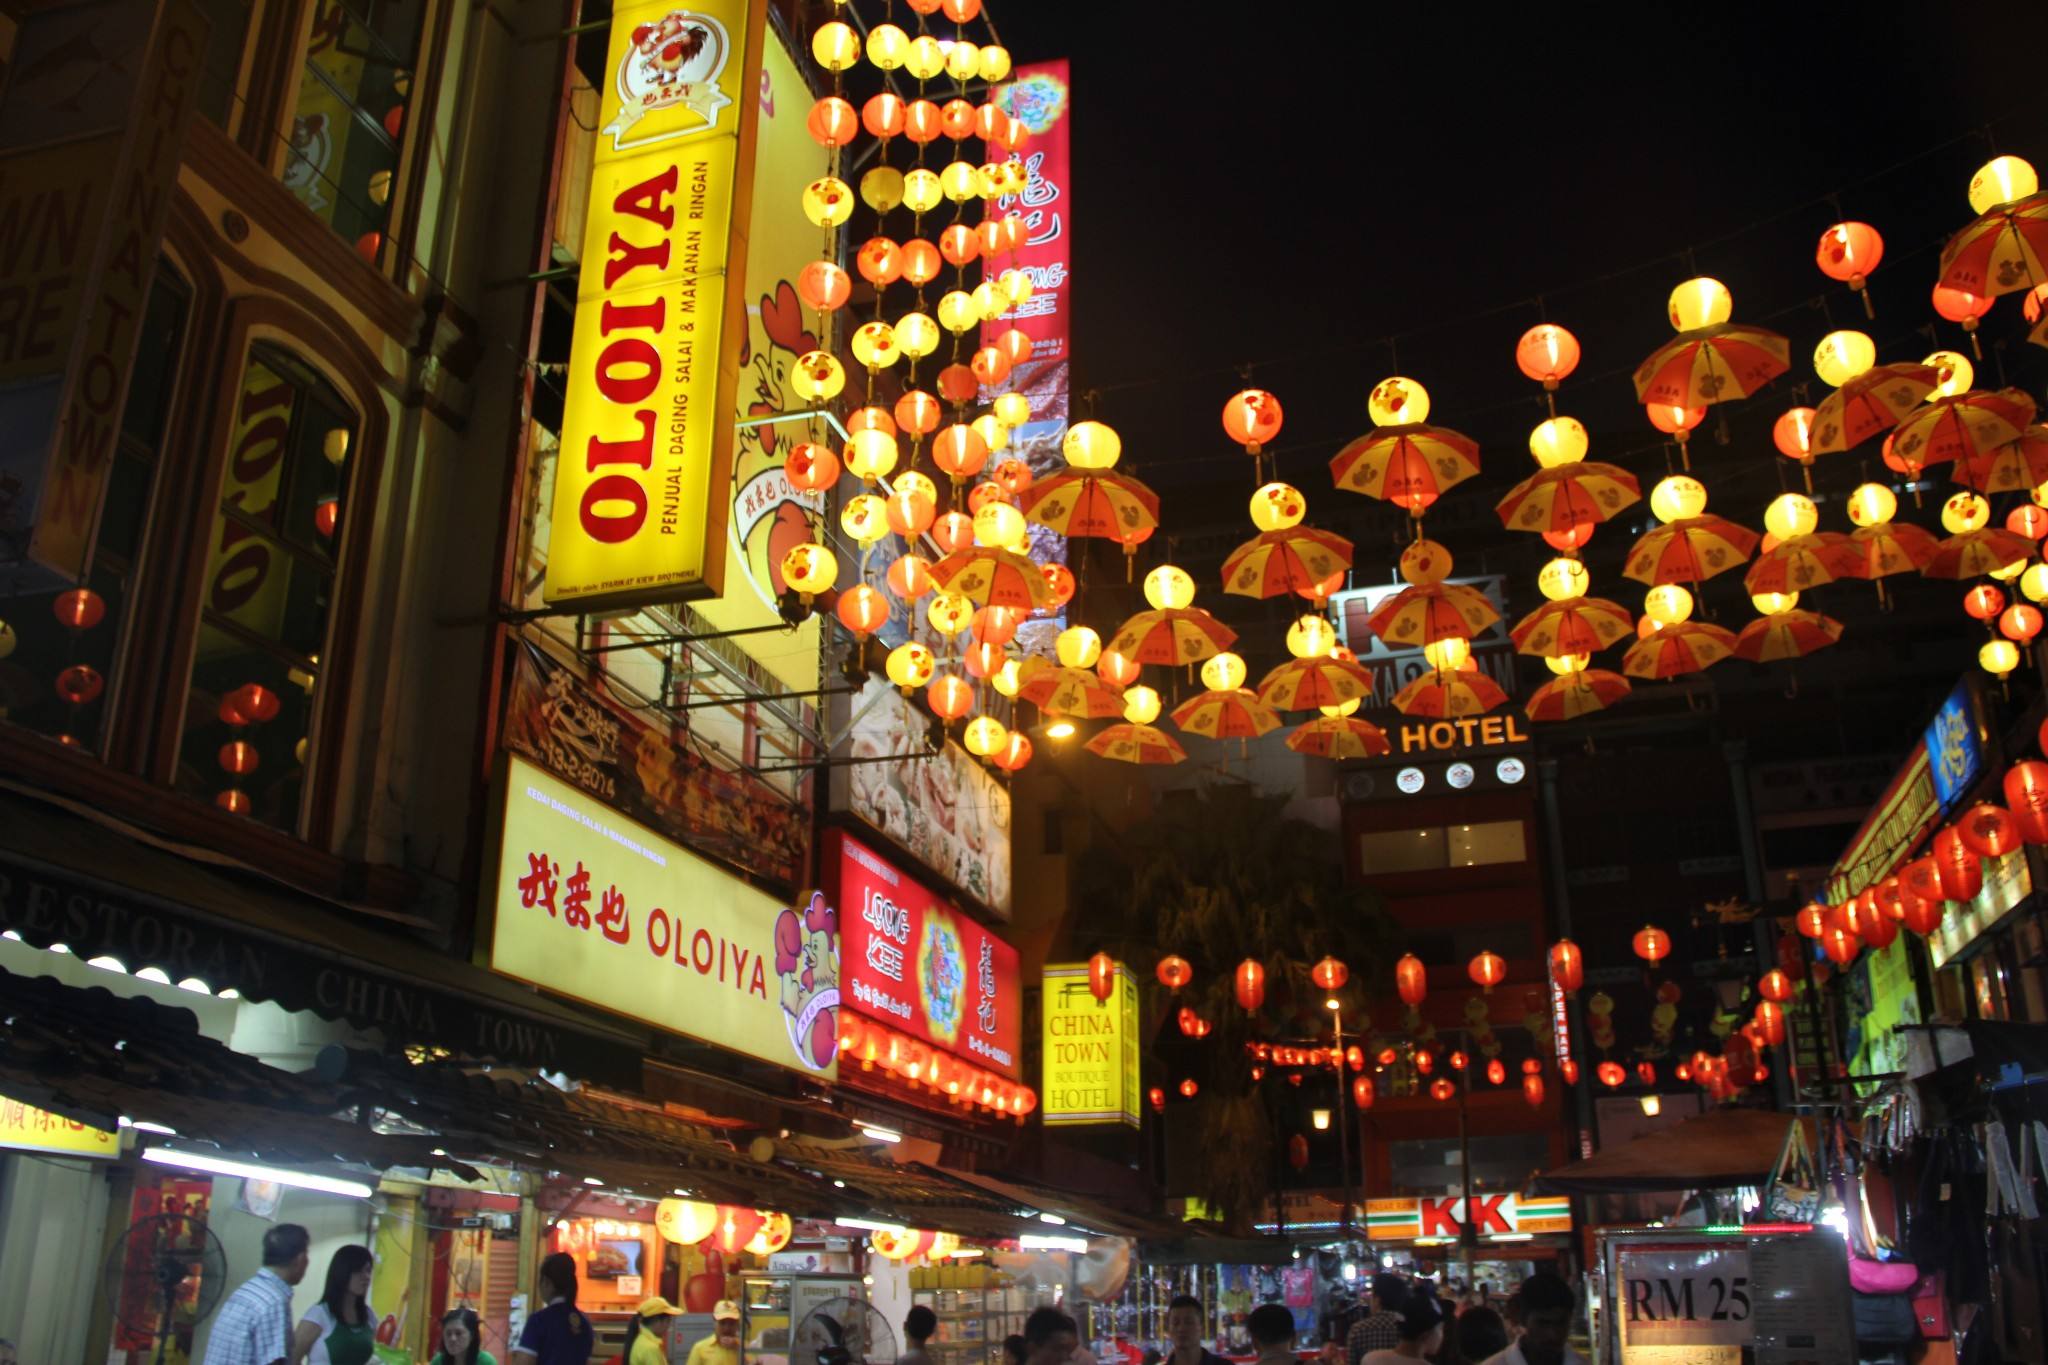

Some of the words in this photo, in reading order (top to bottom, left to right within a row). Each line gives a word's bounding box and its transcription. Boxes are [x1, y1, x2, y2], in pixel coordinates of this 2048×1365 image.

[688, 161, 708, 220] RINGAN
[680, 230, 702, 314] MAKANAN
[680, 322, 694, 332] &
[579, 164, 678, 544] OLOIYA
[675, 340, 693, 383] SALAI
[670, 393, 689, 455] DAGING
[661, 464, 683, 536] PENJUAL
[1400, 714, 1528, 754] HOTEL
[527, 786, 550, 806] KEDAI
[551, 799, 581, 822] DAGING
[582, 815, 601, 833] SALAI
[863, 886, 911, 945] LOONG
[646, 907, 768, 1000] OLOIYA
[866, 933, 904, 982] KEE
[314, 966, 439, 1036] CHINA
[473, 1009, 562, 1062] TOWN
[1049, 1014, 1115, 1037] CHINA
[1054, 1041, 1111, 1064] TOWN
[1051, 1088, 1115, 1109] HOTEL
[1055, 1070, 1111, 1084] BOUTIQUE
[1421, 1195, 1512, 1236] KK
[1626, 1278, 1696, 1322] RM
[1708, 1277, 1751, 1322] 25
